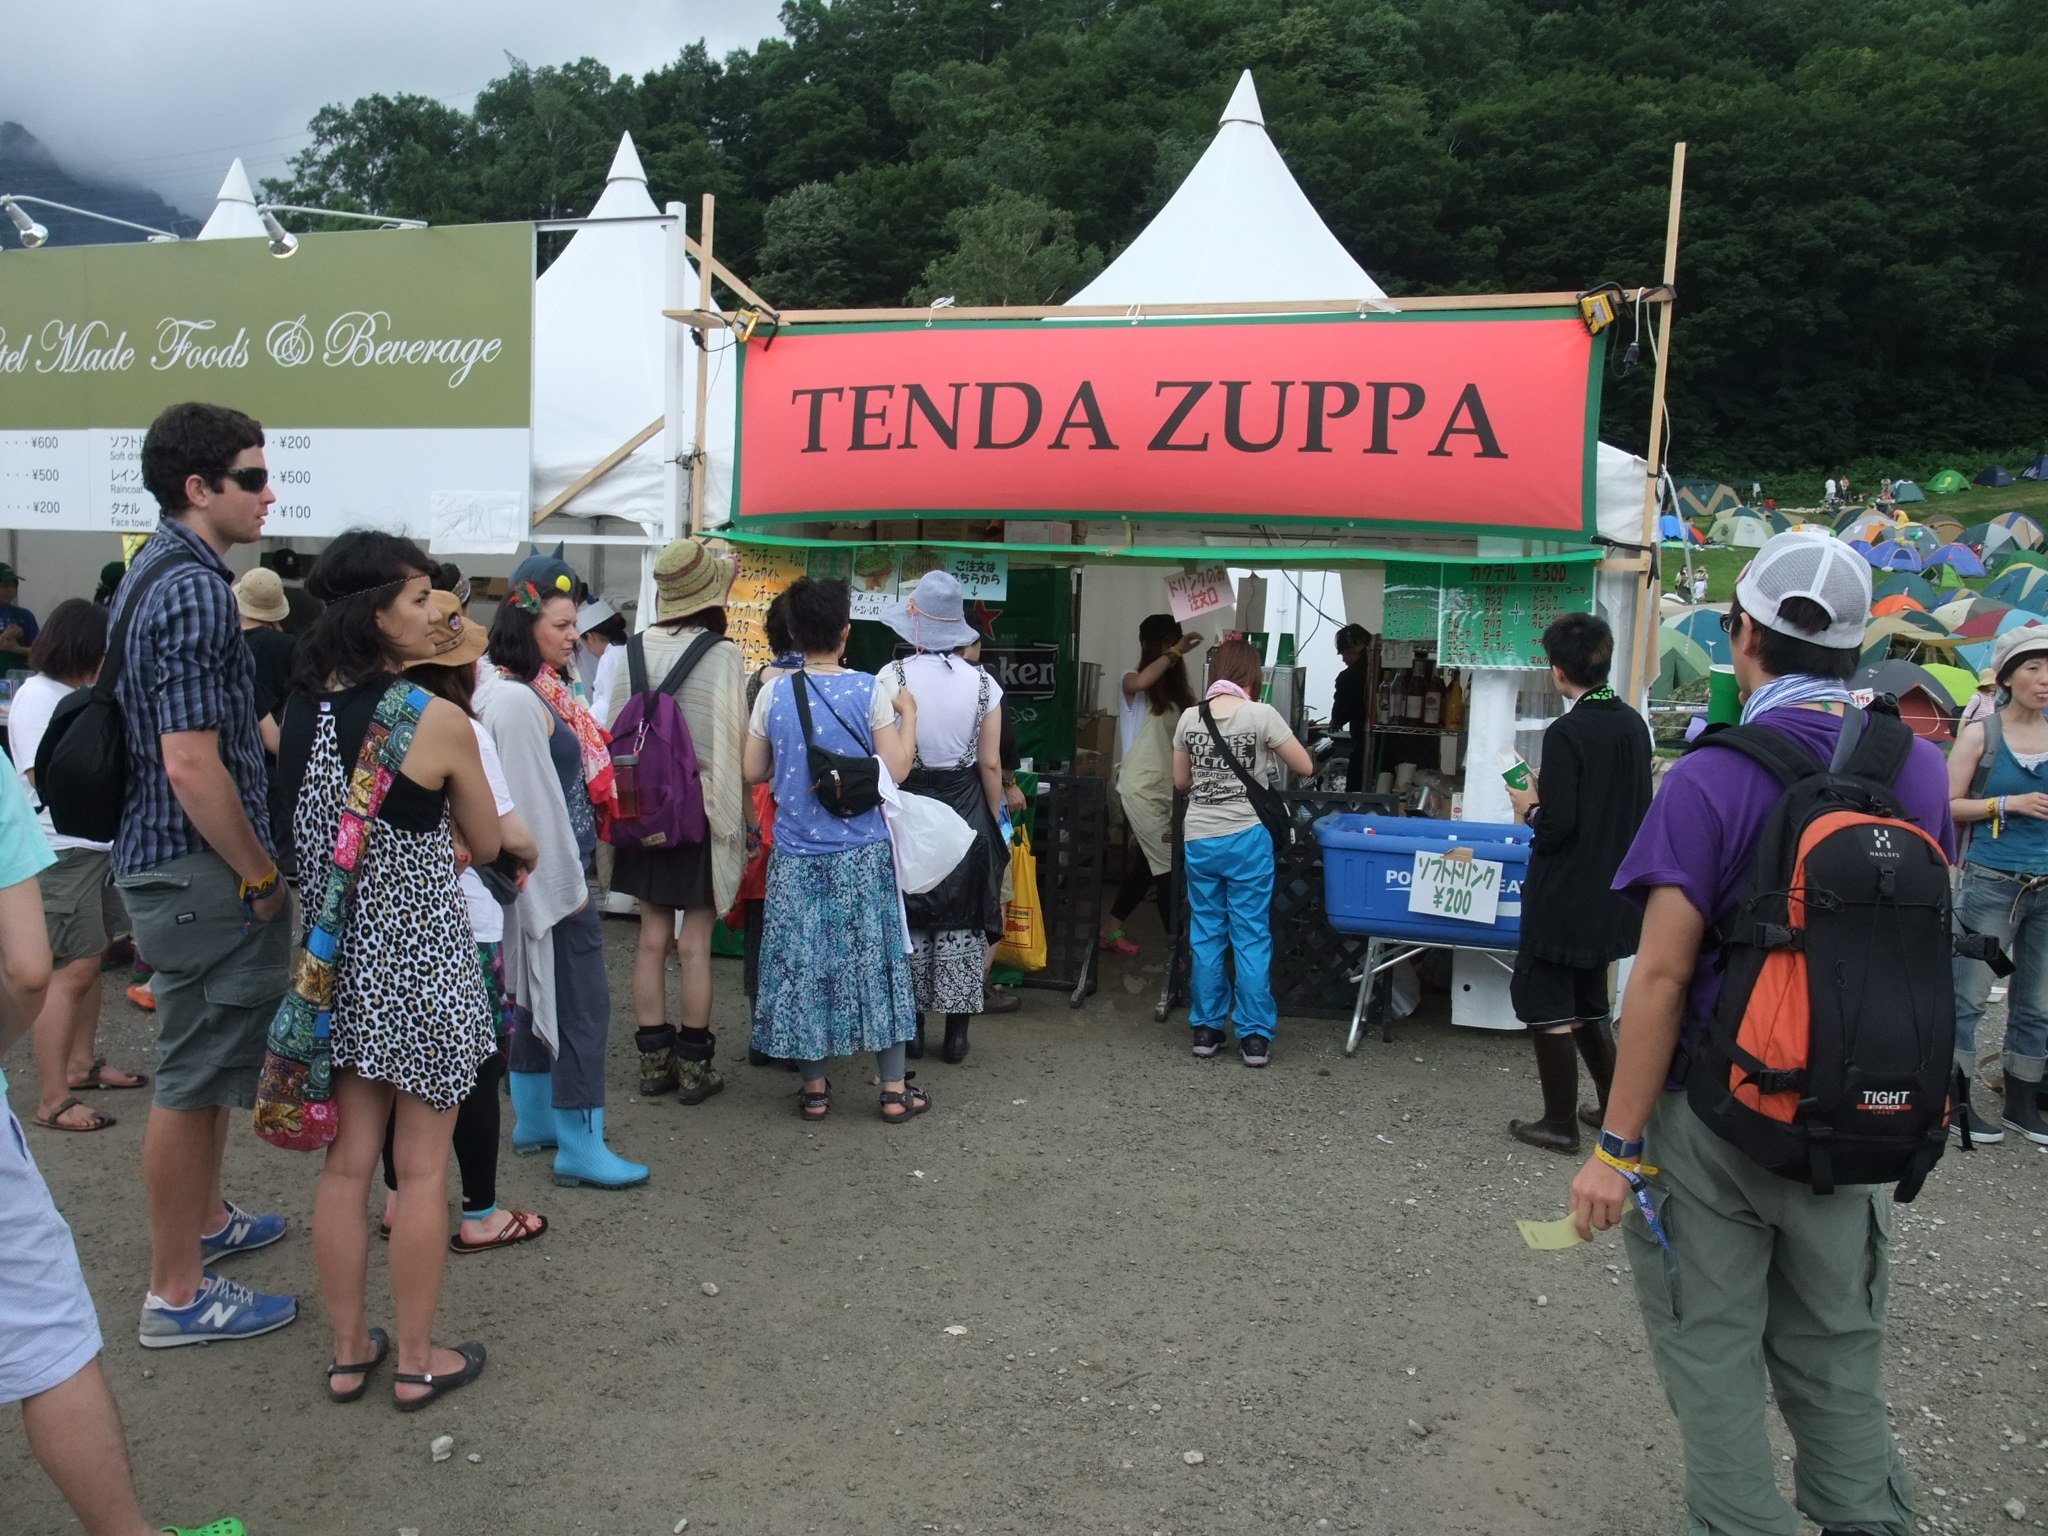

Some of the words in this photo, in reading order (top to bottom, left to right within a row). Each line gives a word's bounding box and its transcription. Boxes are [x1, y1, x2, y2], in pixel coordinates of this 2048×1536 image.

[0, 330, 32, 373] tel
[36, 319, 136, 373] Made
[151, 317, 250, 371] Foods
[266, 314, 314, 367] &
[322, 311, 502, 389] Beverage
[791, 379, 1120, 453] TENDA
[1147, 380, 1509, 459] ZUPPA
[31, 436, 59, 449] ¥600
[280, 435, 311, 449] ¥200
[110, 451, 125, 461] Soft
[32, 469, 60, 481] ¥500
[111, 468, 143, 481] レイン
[280, 470, 311, 484] ¥500
[110, 484, 144, 494] Raincoat
[33, 501, 60, 513] ¥200
[111, 501, 140, 515] タオル
[280, 505, 311, 519] ¥100
[111, 517, 129, 527] Face
[131, 517, 152, 527] towel
[956, 560, 996, 573] ご注文は
[1470, 566, 1518, 582] カクテル
[1531, 564, 1567, 582] ¥500
[1419, 857, 1495, 890] ソフトドリンク
[1432, 885, 1472, 915] ¥200
[1863, 1091, 1910, 1104] TIGHT
[225, 1223, 250, 1245] N
[198, 1302, 238, 1327] N
